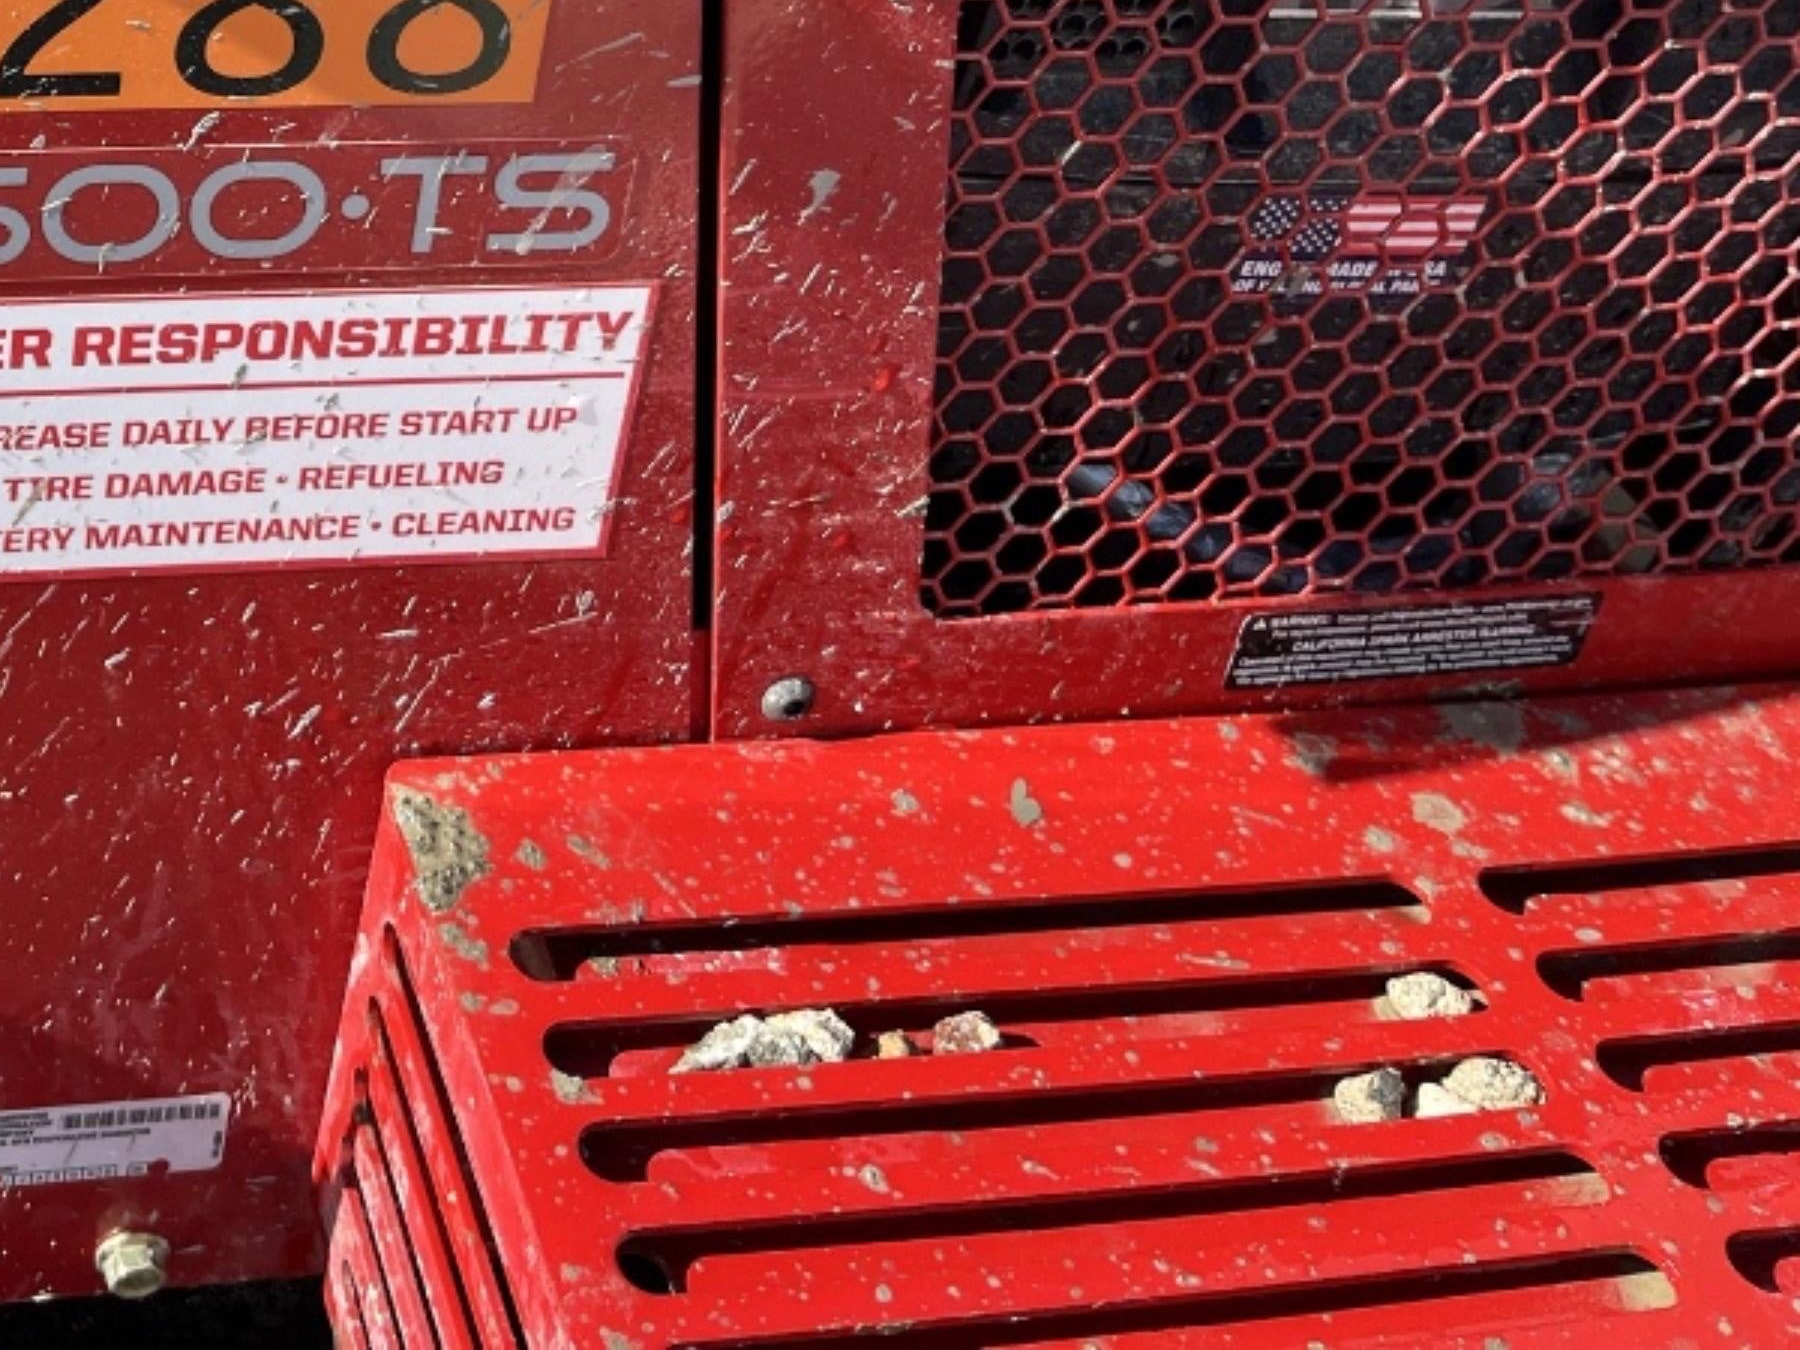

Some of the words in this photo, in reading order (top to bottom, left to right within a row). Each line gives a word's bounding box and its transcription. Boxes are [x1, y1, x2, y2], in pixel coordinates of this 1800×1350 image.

[71, 311, 633, 368] RESPONSIBILITY
[122, 417, 234, 446] DAILY
[244, 412, 389, 441] BEFORE
[399, 408, 519, 437] START
[528, 406, 578, 433] UP
[3, 475, 93, 502] TIRE
[104, 467, 267, 499] DAMAGE
[298, 460, 505, 491] REFUELING
[85, 516, 359, 549] MAINTENANCE
[392, 506, 575, 537] CLEANING
